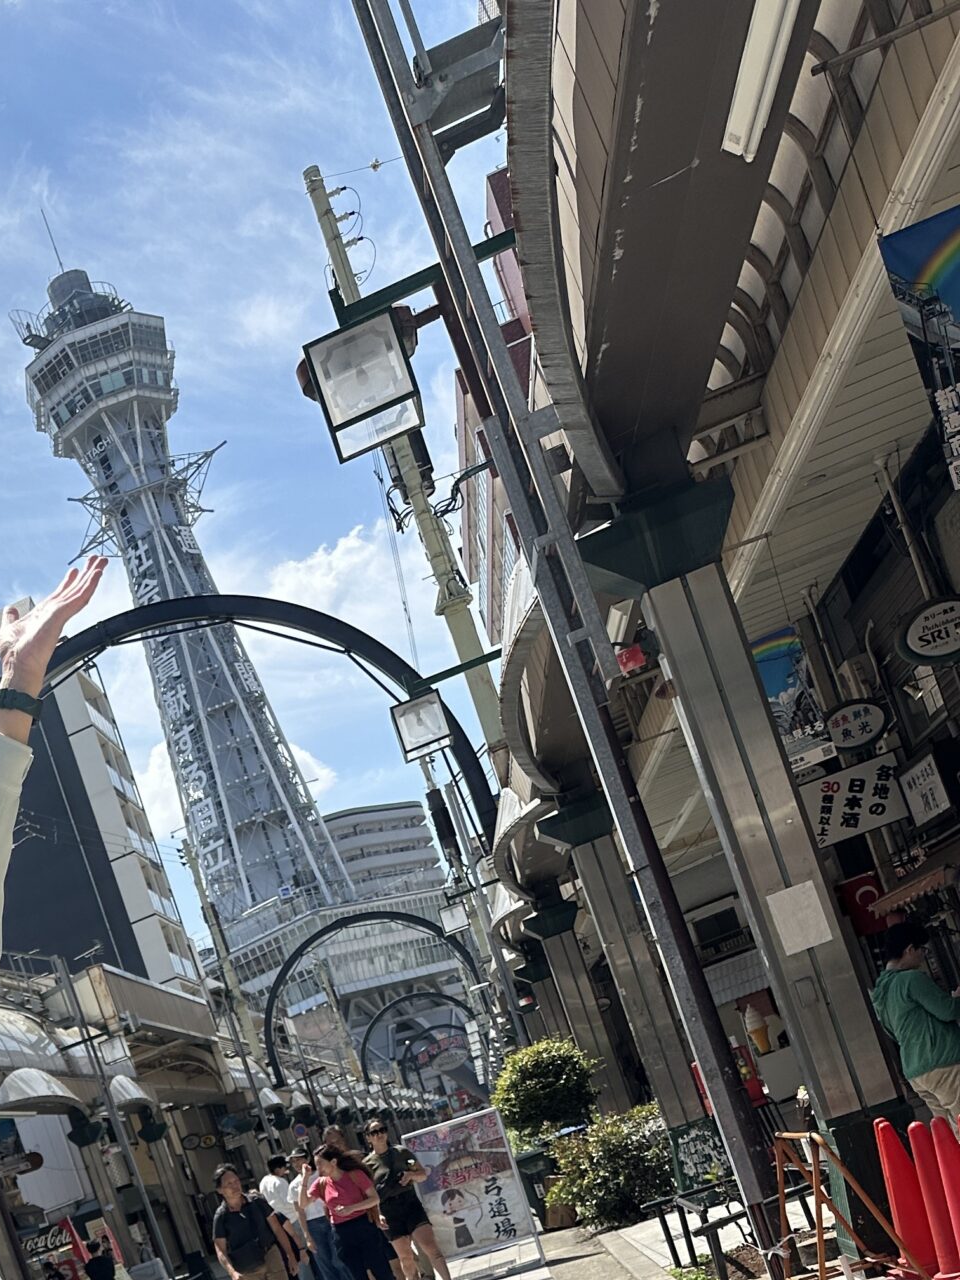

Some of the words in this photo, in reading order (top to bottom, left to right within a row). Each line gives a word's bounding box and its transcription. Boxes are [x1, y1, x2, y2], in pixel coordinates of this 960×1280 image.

[81, 434, 114, 464] ITACHI
[127, 539, 231, 875] 社会貢献する日立
[840, 778, 866, 828] 日本酒
[869, 765, 893, 816] 各地の
[484, 1177, 517, 1239] 弓道場
